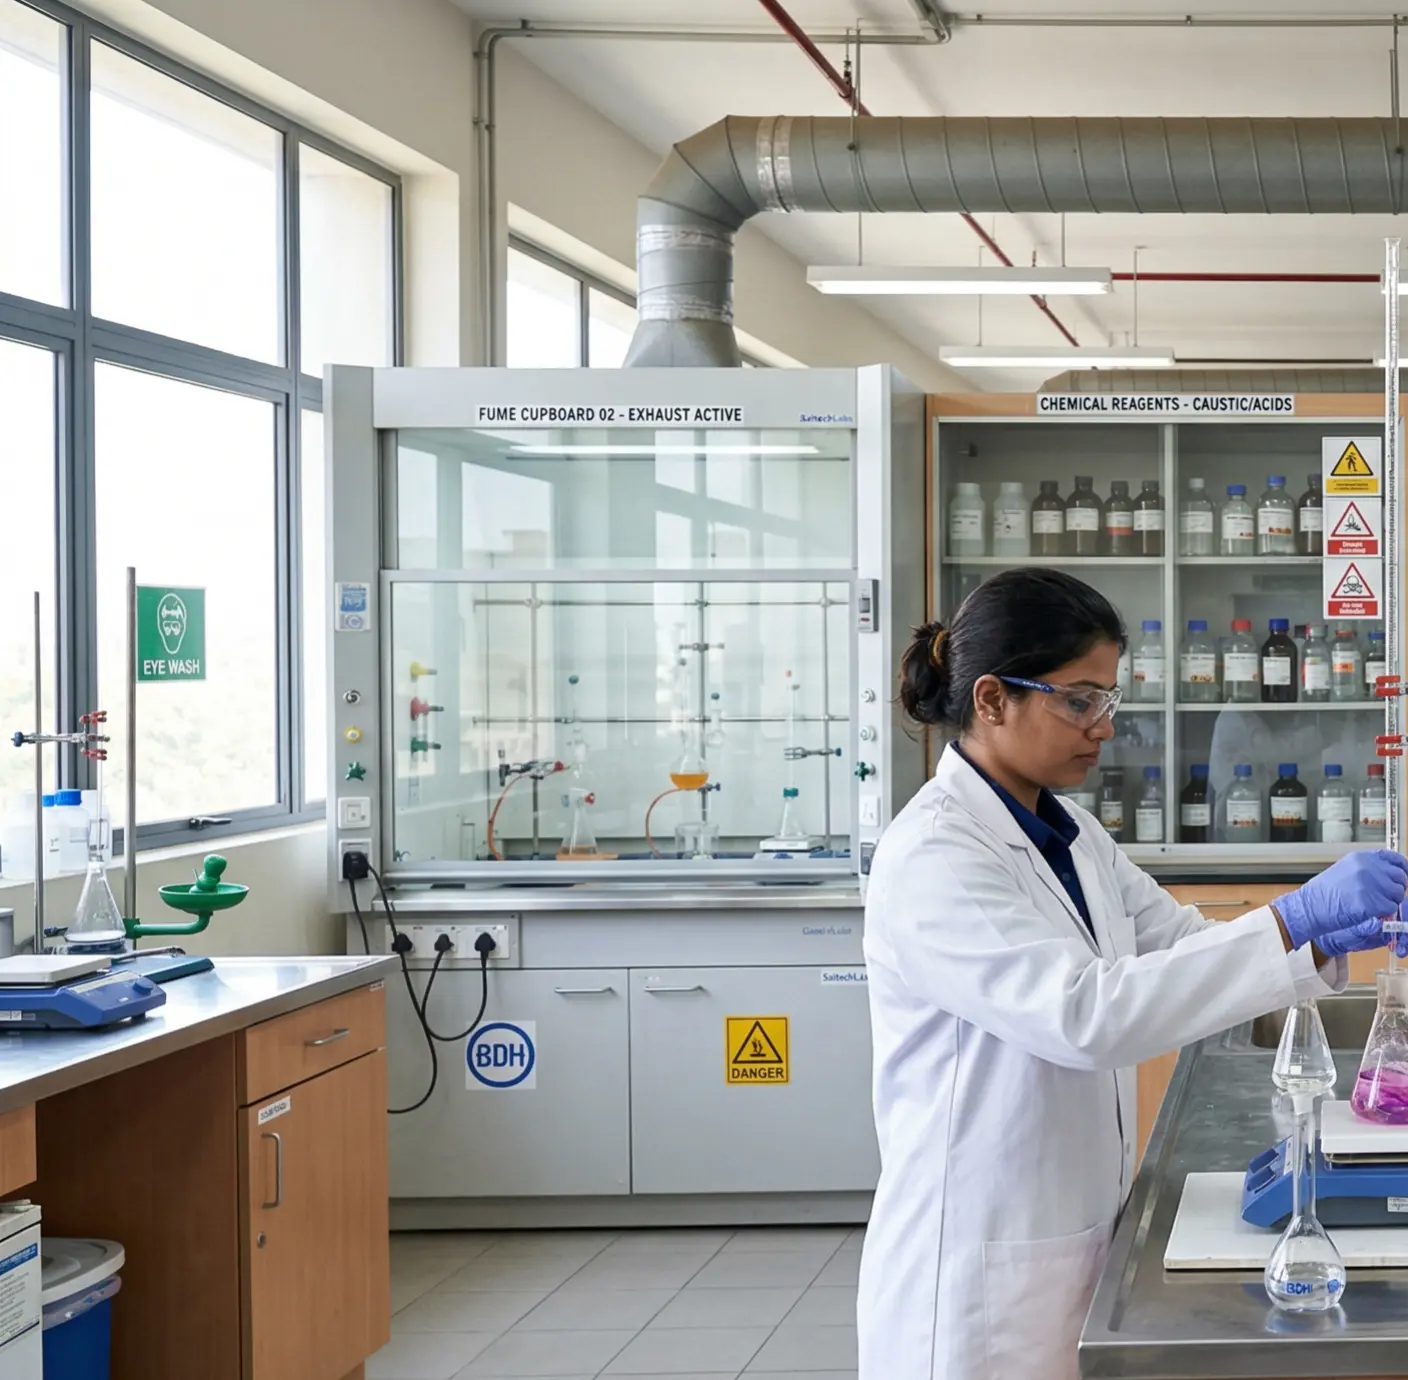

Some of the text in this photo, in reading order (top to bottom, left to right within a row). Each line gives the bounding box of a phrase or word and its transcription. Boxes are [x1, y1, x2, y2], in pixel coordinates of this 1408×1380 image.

[1040, 396, 1107, 411] CHEMICAL
[1112, 396, 1180, 411] REAGENTS
[1193, 396, 1293, 412] CAUSTIC/ACIDS
[479, 407, 517, 421] FUME
[521, 407, 595, 421] CUPBOARD
[599, 407, 615, 421] 02
[629, 407, 690, 421] EXHAUST
[694, 407, 742, 421] ACTIVE
[143, 658, 200, 675] EYE WASH
[476, 1043, 525, 1067] BDH
[731, 1067, 784, 1079] DANGER
